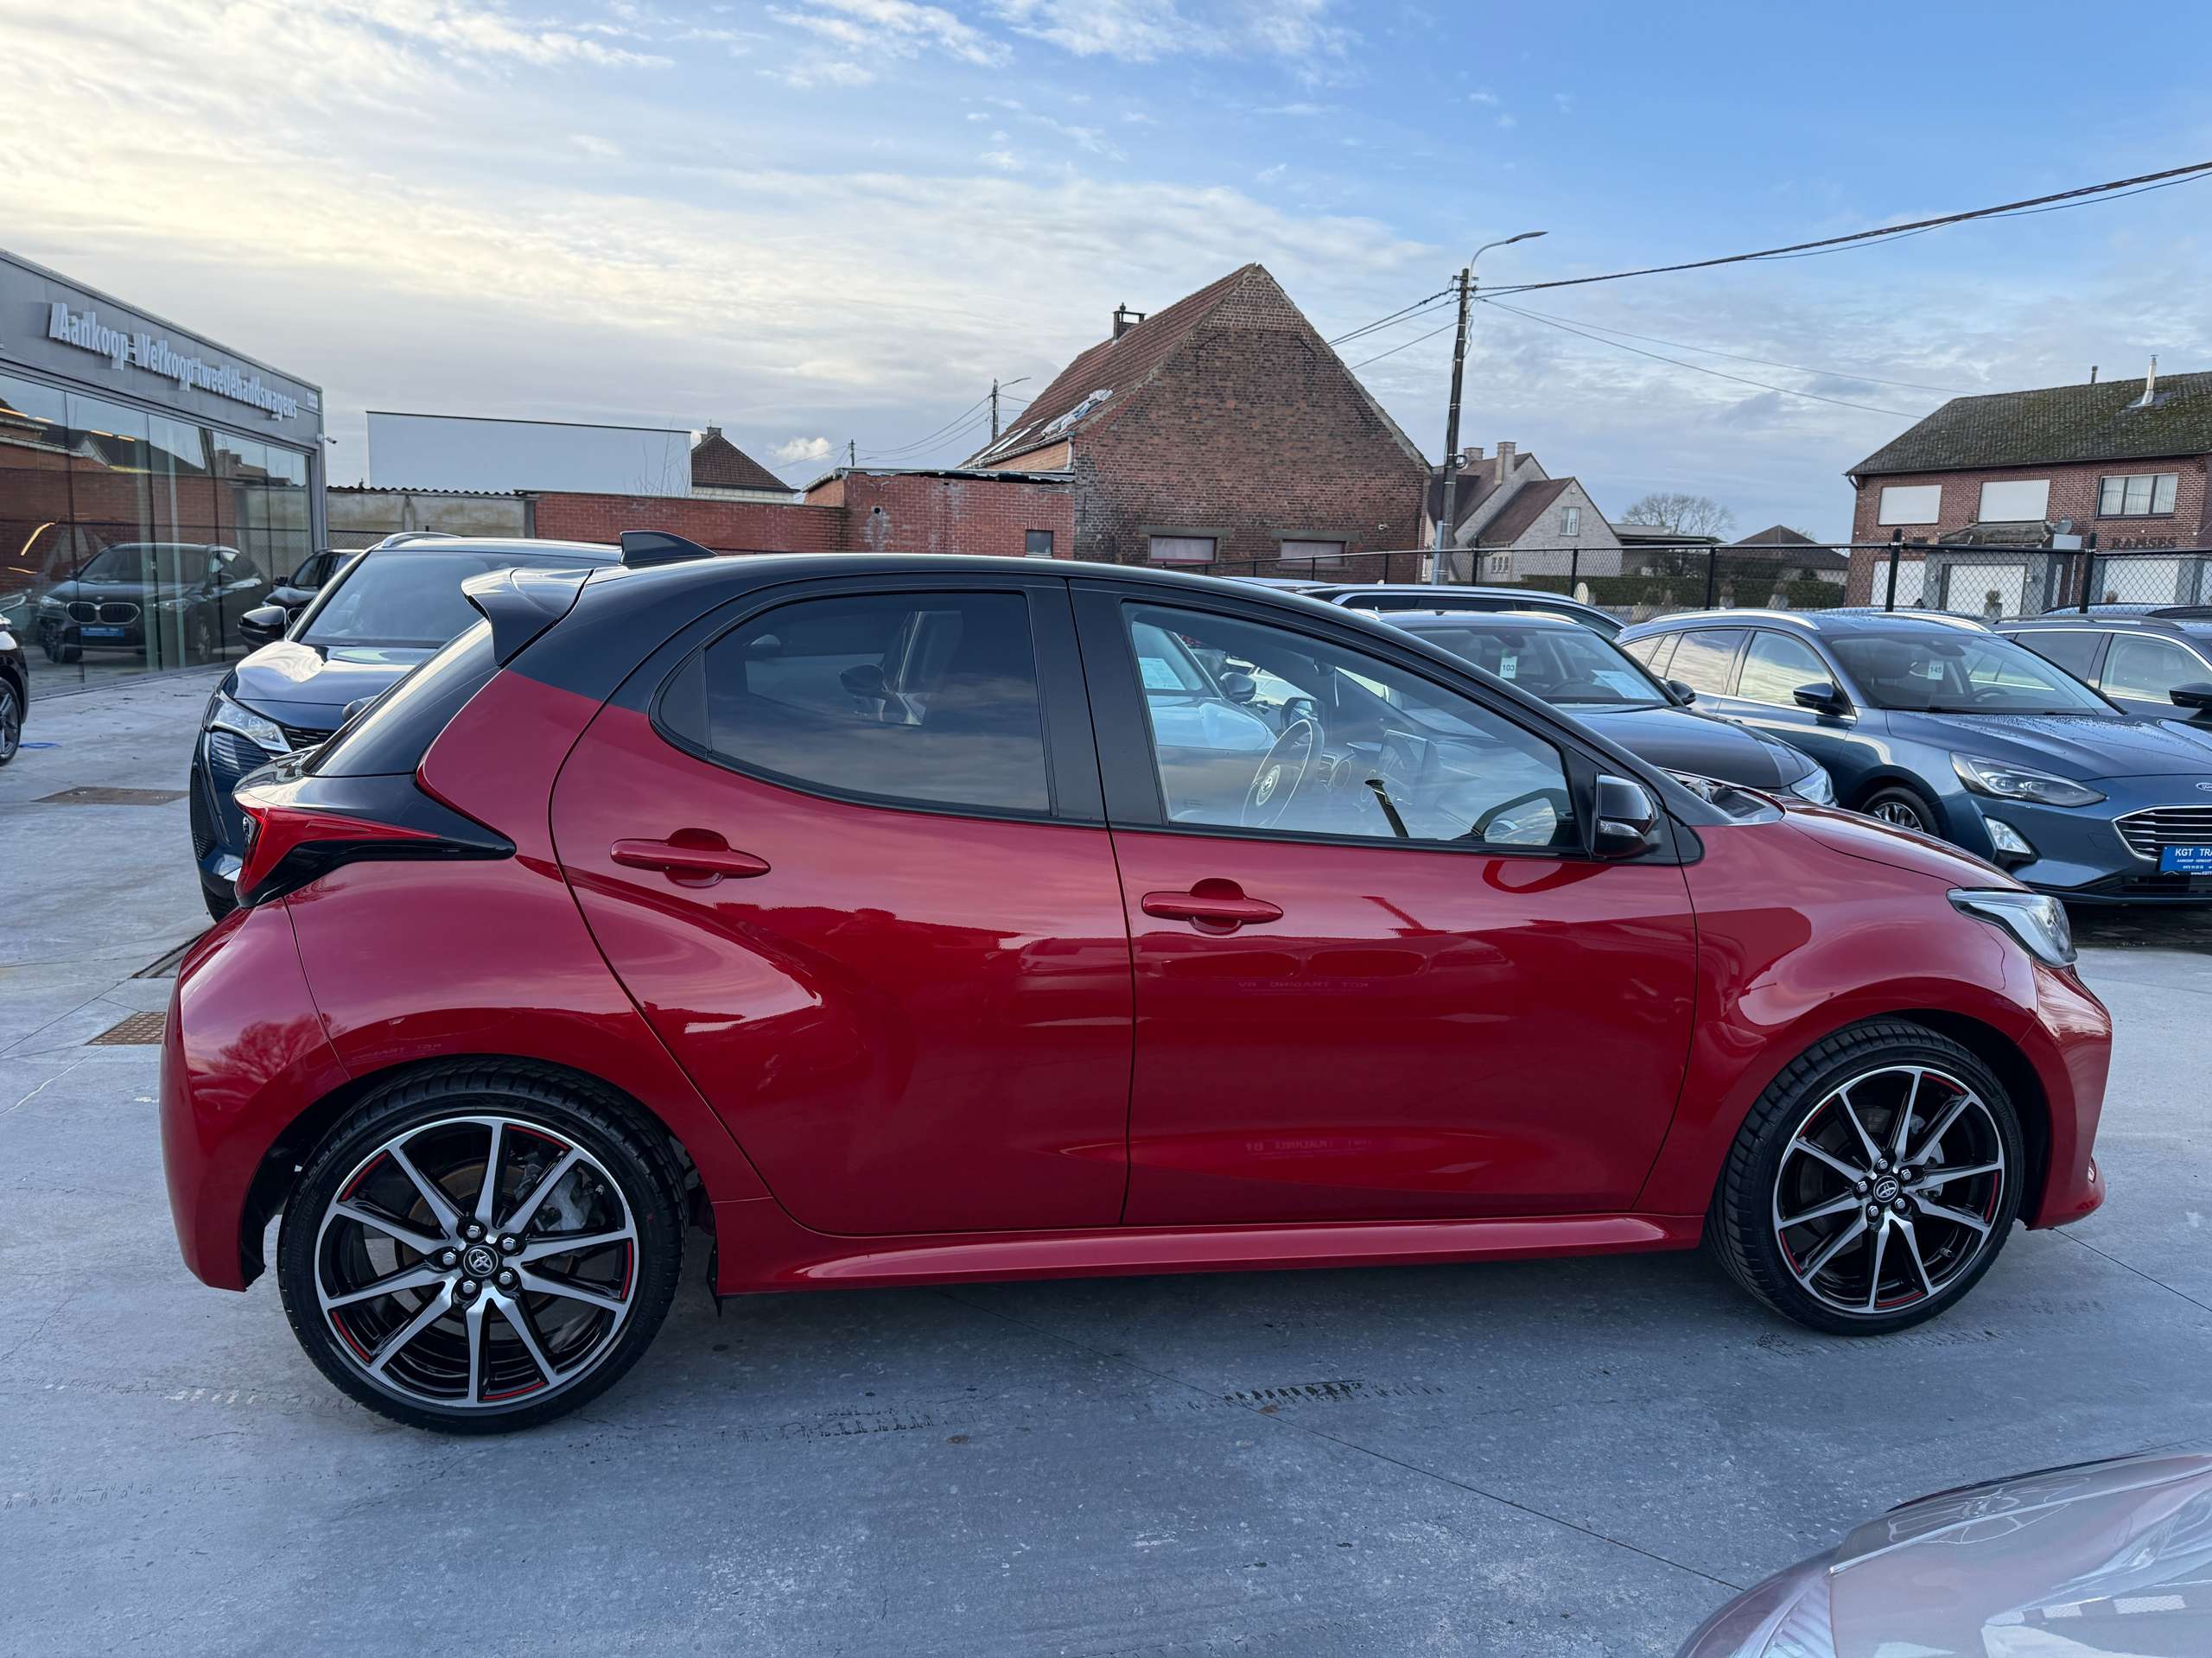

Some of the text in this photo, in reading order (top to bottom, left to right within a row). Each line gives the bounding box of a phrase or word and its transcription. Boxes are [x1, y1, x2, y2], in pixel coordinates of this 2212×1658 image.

[49, 302, 129, 371] Aankoop
[134, 333, 194, 392] Verkoop
[192, 357, 298, 422] tweedehandswagens
[2175, 848, 2194, 857] KGT
